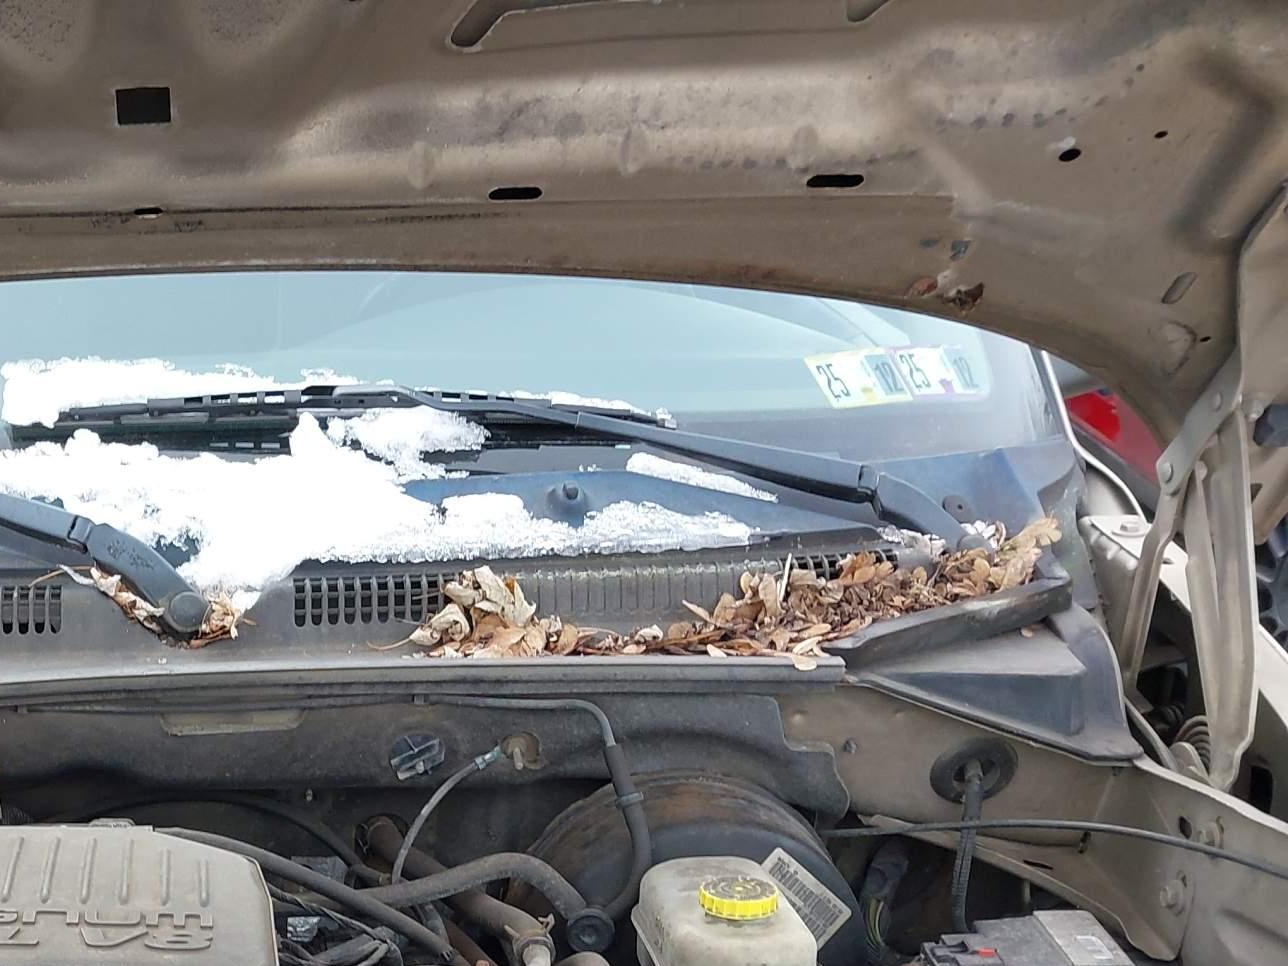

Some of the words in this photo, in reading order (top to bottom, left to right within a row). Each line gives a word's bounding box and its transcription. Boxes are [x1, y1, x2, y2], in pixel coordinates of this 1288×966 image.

[816, 363, 851, 398] 25
[874, 361, 905, 393] 12
[899, 354, 931, 389] 25
[80, 927, 214, 951] V8
